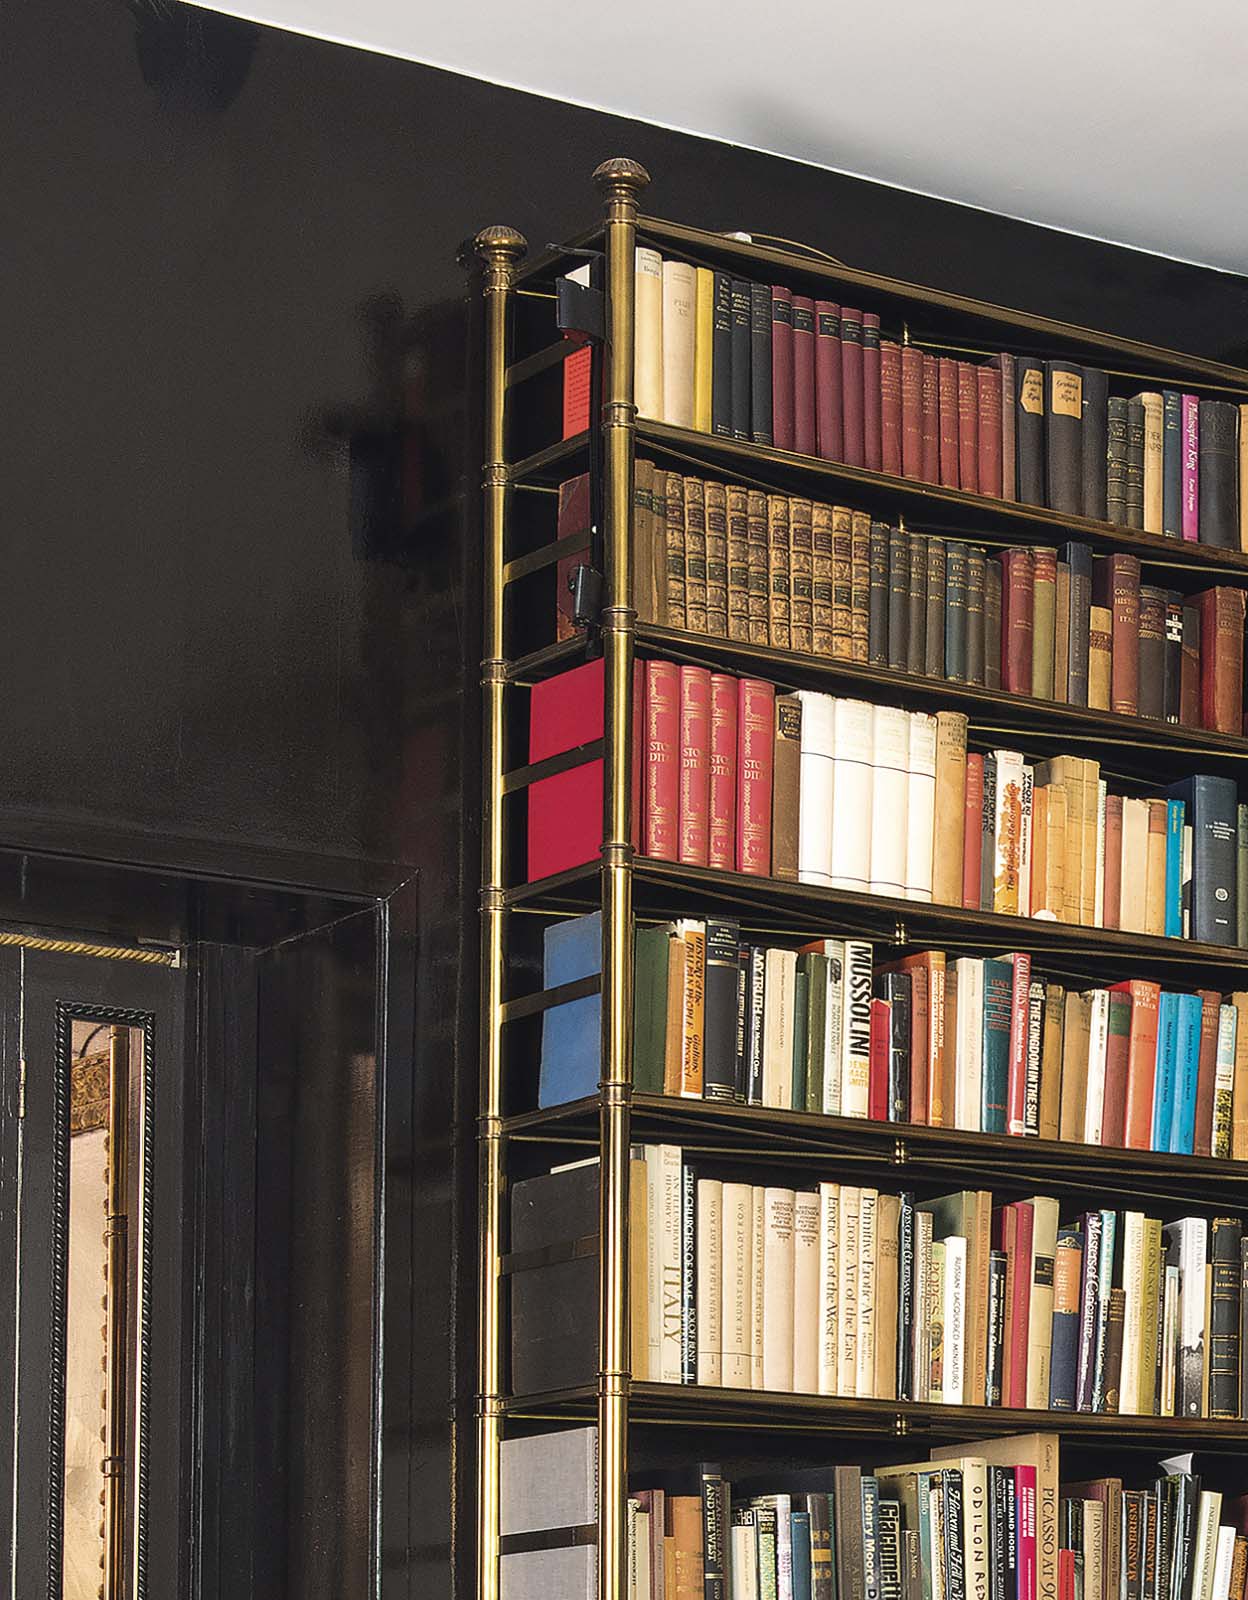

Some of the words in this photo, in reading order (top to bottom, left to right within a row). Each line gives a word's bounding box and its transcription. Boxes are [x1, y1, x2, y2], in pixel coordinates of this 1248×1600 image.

[1008, 780, 1017, 835] Reformation
[1007, 838, 1016, 872] Radical
[1016, 957, 1028, 1005] COLUMBUS
[849, 944, 872, 1057] MUSSOLINI
[1033, 1000, 1042, 1018] THE
[1029, 1018, 1041, 1064] KINGDOM
[828, 1196, 838, 1236] Erotic
[863, 1197, 874, 1257] Primitive
[827, 1239, 837, 1262] Art
[847, 1215, 858, 1255] Erotic
[827, 1264, 836, 1277] of
[847, 1260, 857, 1282] Art
[862, 1260, 874, 1300] Erotic
[664, 1266, 681, 1344] ITALY
[827, 1278, 837, 1302] the
[846, 1288, 856, 1301] of
[827, 1305, 837, 1337] West
[845, 1305, 856, 1327] the
[861, 1307, 873, 1324] Art
[845, 1334, 856, 1361] East
[706, 1484, 716, 1507] AND
[707, 1508, 717, 1530] THE
[864, 1494, 876, 1533] Henry
[972, 1486, 983, 1562] ODILON
[1042, 1488, 1054, 1554] PICASSO
[707, 1531, 717, 1561] WEST
[865, 1540, 876, 1583] Moore
